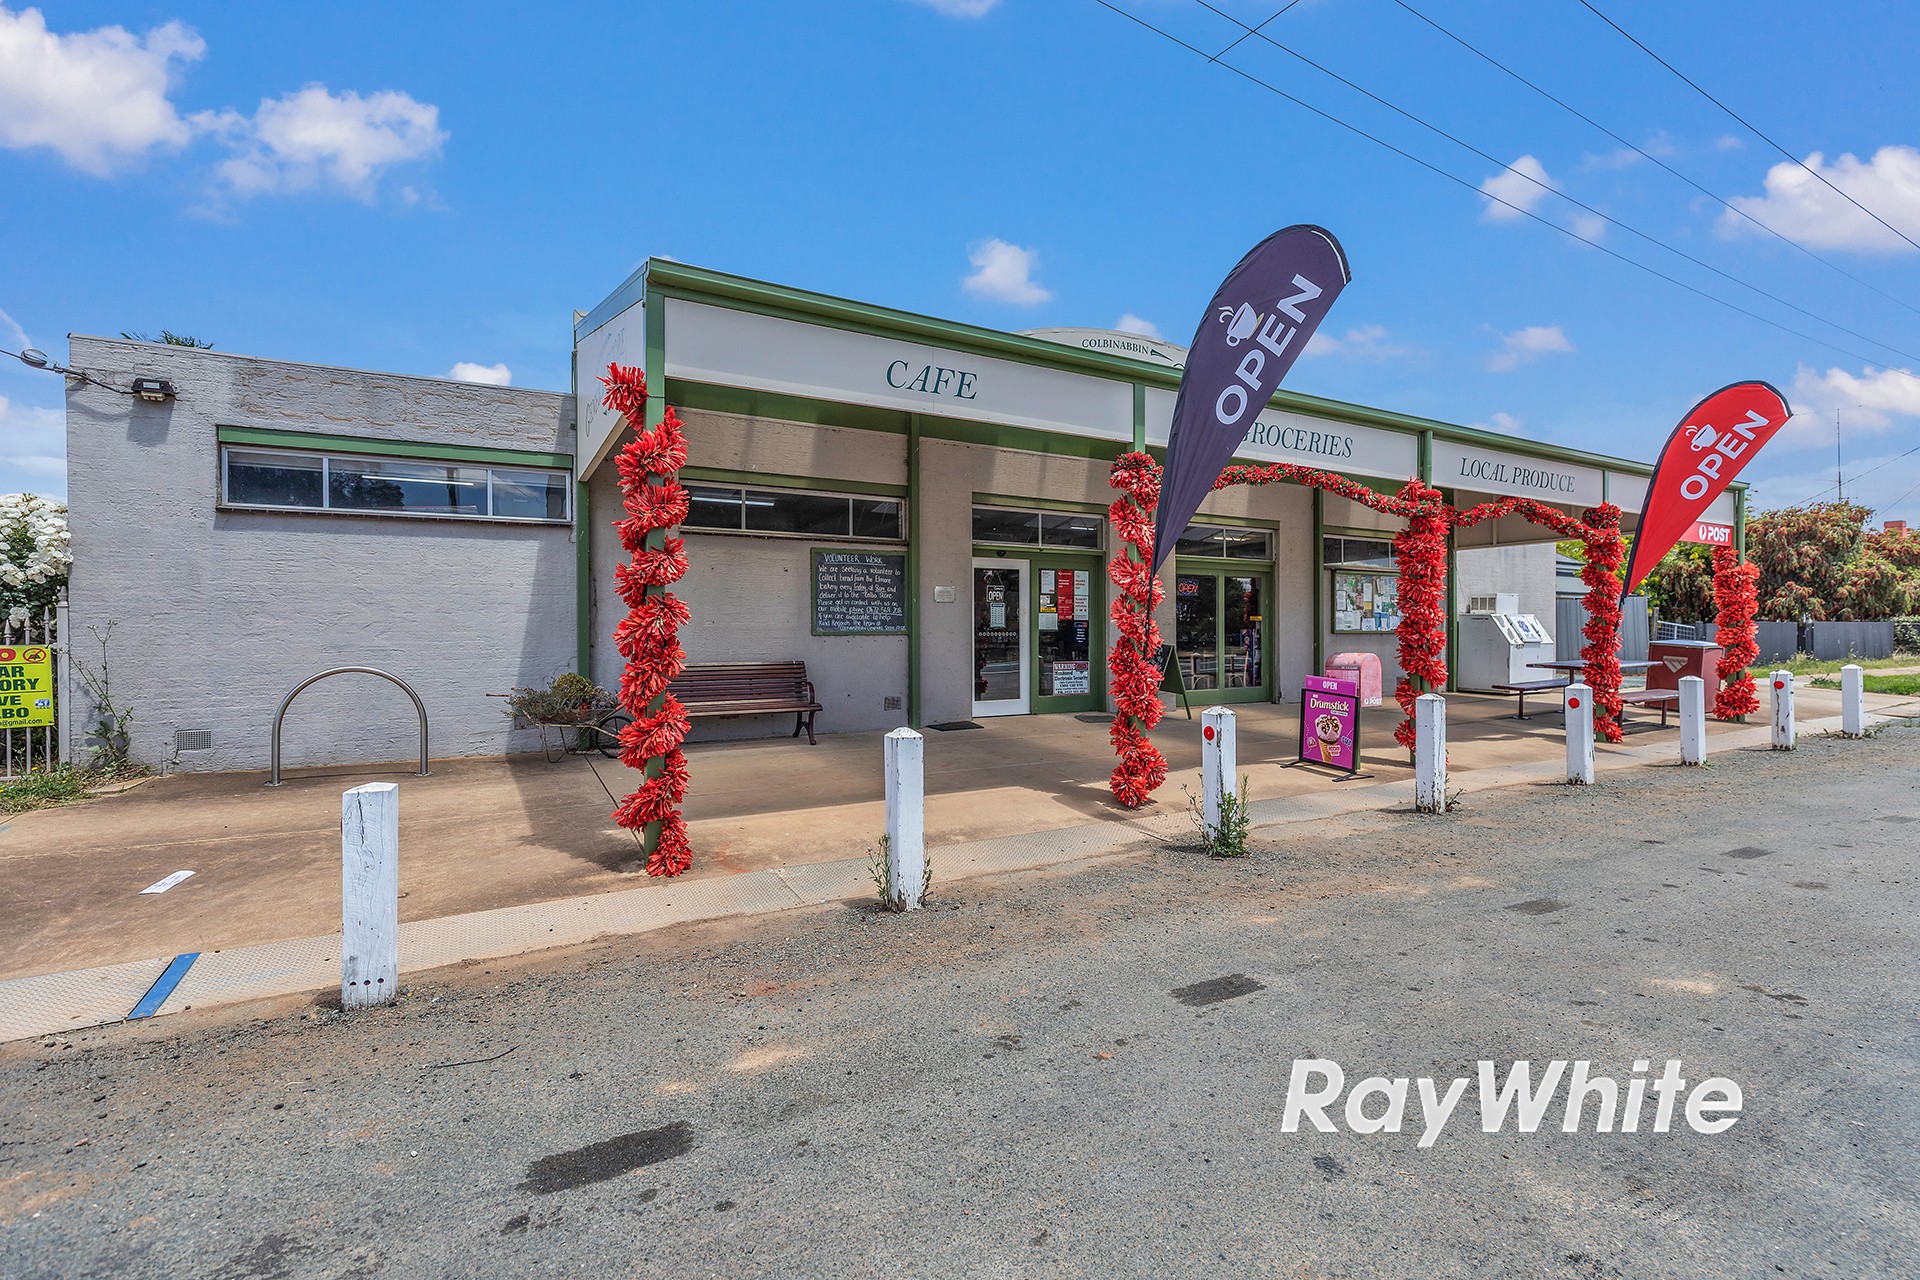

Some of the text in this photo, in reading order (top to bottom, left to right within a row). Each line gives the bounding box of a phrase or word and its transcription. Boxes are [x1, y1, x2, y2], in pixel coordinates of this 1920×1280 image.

[1081, 339, 1149, 355] COLBINABBIN
[1215, 273, 1324, 425] OPEN
[886, 360, 978, 400] CAFE
[1680, 409, 1770, 500] OPEN
[1460, 457, 1575, 493] LOCAL PRODUCE
[1708, 526, 1730, 543] POST
[823, 553, 883, 564] VOLUNTEER WORK
[988, 591, 1003, 601] OPEN
[1178, 583, 1198, 593] OPEN
[1322, 681, 1338, 690] OPEN
[1310, 698, 1349, 711] Drumstick
